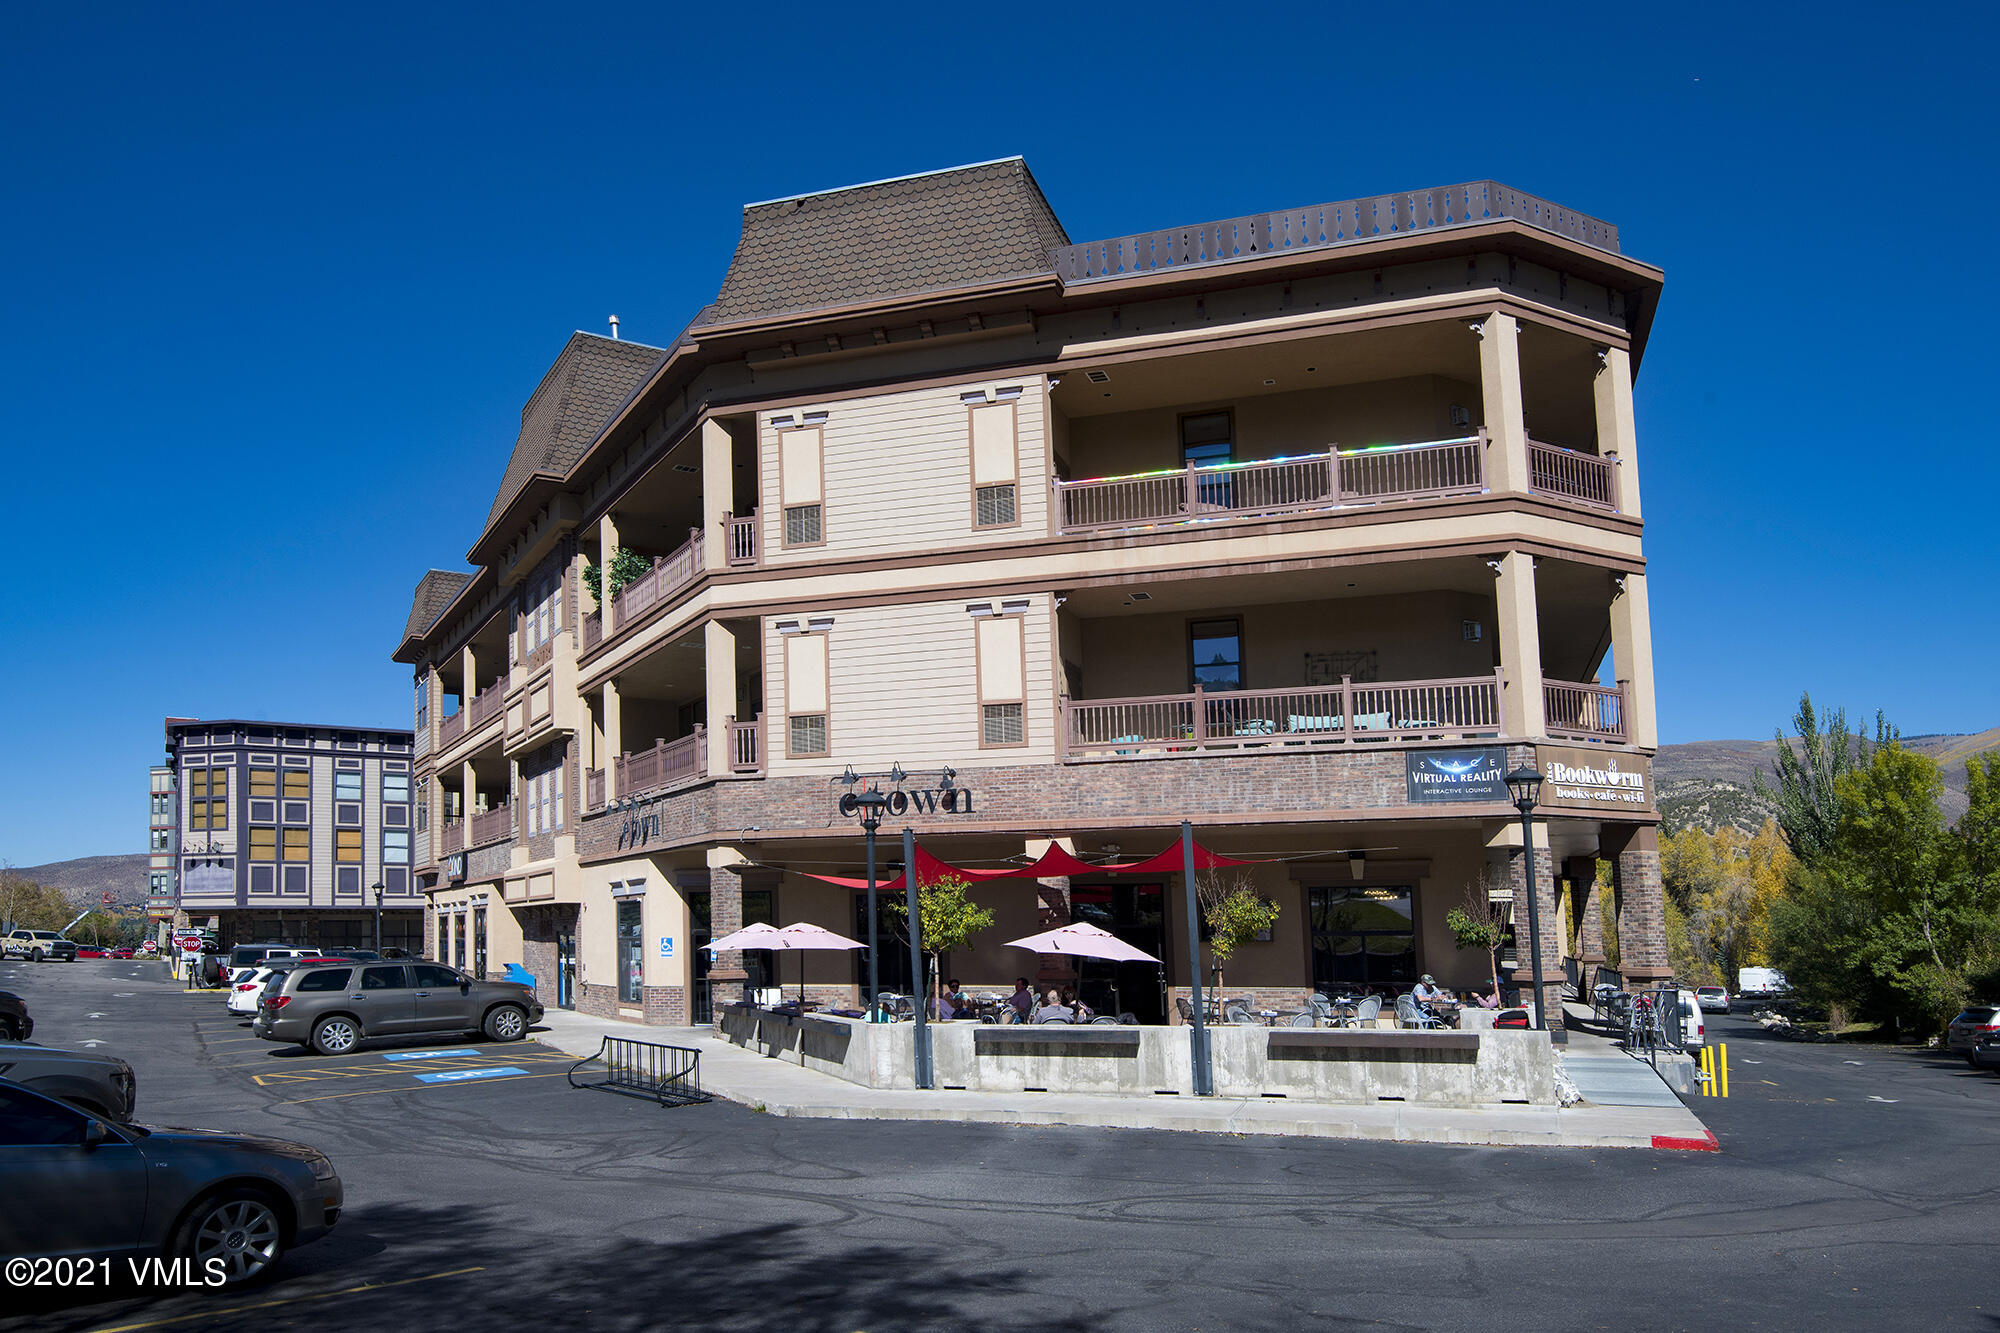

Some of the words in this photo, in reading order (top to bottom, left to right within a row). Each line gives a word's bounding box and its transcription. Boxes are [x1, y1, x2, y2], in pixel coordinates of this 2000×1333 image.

[1420, 759, 1495, 769] SPACE
[1412, 771, 1456, 784] VIRTUAL
[1460, 768, 1502, 782] REALITY
[1556, 786, 1590, 800] books
[1594, 789, 1617, 802] café
[183, 940, 200, 948] STOP
